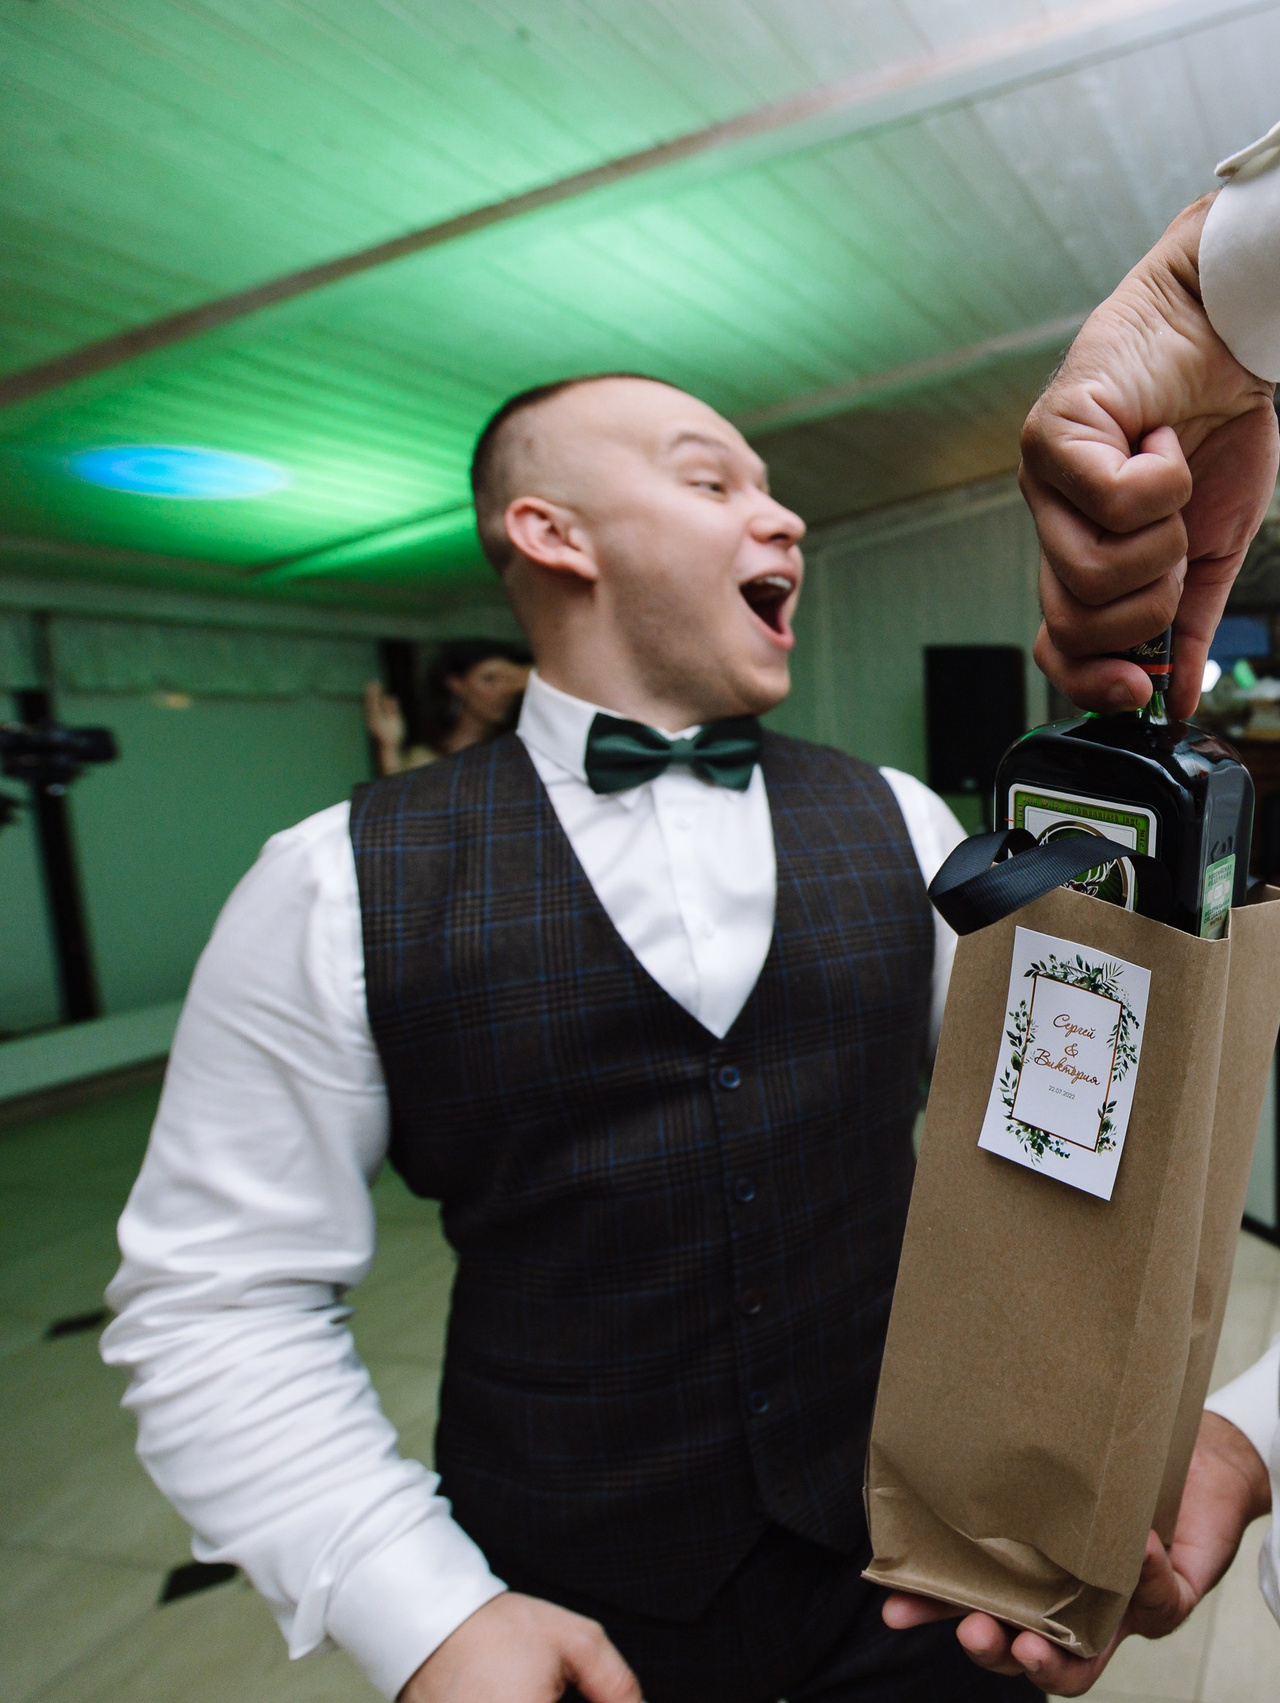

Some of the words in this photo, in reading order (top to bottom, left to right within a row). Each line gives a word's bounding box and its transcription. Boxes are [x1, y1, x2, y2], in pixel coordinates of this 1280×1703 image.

[1053, 1014, 1096, 1039] Сергей
[1064, 1043, 1079, 1058] &
[1034, 1048, 1100, 1085] Виктория
